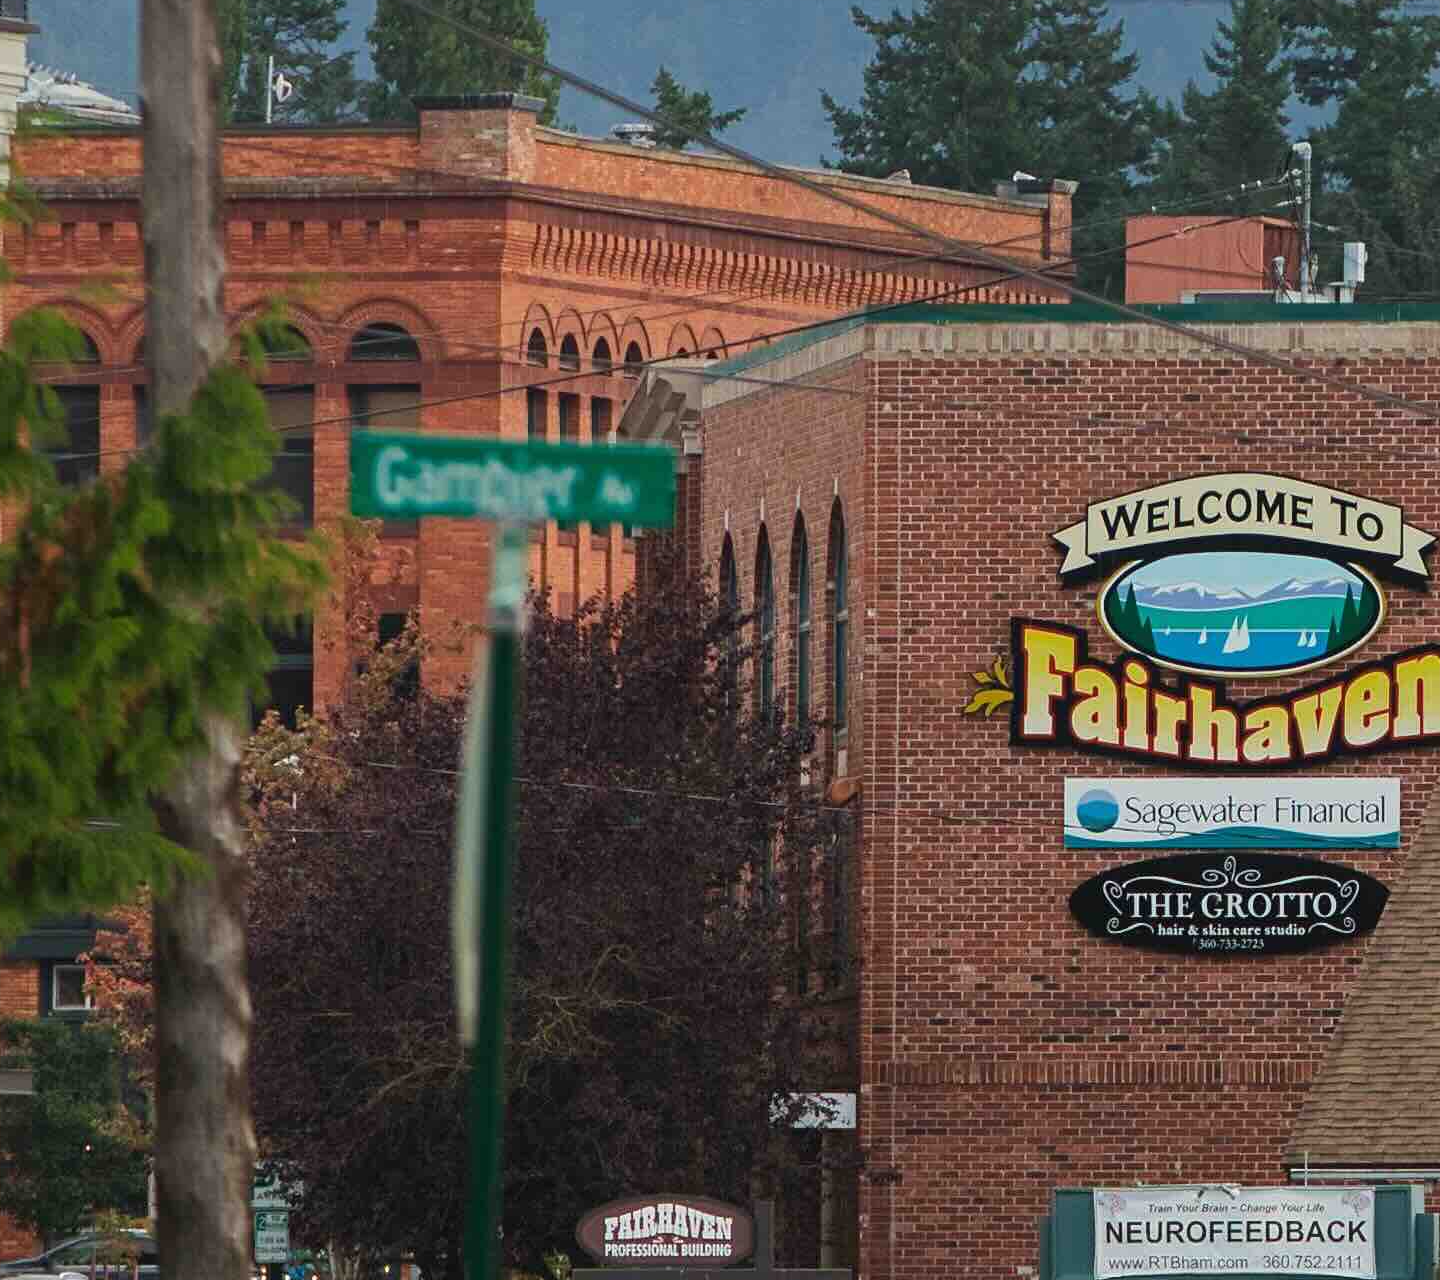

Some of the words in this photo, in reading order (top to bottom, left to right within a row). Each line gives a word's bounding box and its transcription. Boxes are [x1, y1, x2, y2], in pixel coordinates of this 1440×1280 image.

[1101, 487, 1314, 541] WELCOME
[1124, 794, 1266, 836] Sagewater
[1275, 796, 1386, 824] Financial
[1126, 892, 1195, 919] THE
[1201, 892, 1338, 919] GROTTO
[1158, 924, 1185, 936] hair
[1187, 925, 1200, 936] &
[1202, 924, 1230, 936] skin
[1233, 926, 1261, 936] care
[1264, 924, 1306, 936] studio
[604, 1202, 733, 1241] FAIRHAVEN
[1148, 1203, 1172, 1214] Train
[1175, 1203, 1198, 1214] Your
[1201, 1203, 1229, 1214] Brain
[1240, 1203, 1278, 1216] Change
[1281, 1203, 1303, 1214] Your
[1306, 1203, 1325, 1214] Life
[1106, 1220, 1367, 1244] NEUROFEEDBACK
[604, 1243, 679, 1258] PROFESSIONAL
[681, 1243, 732, 1257] BUILDING
